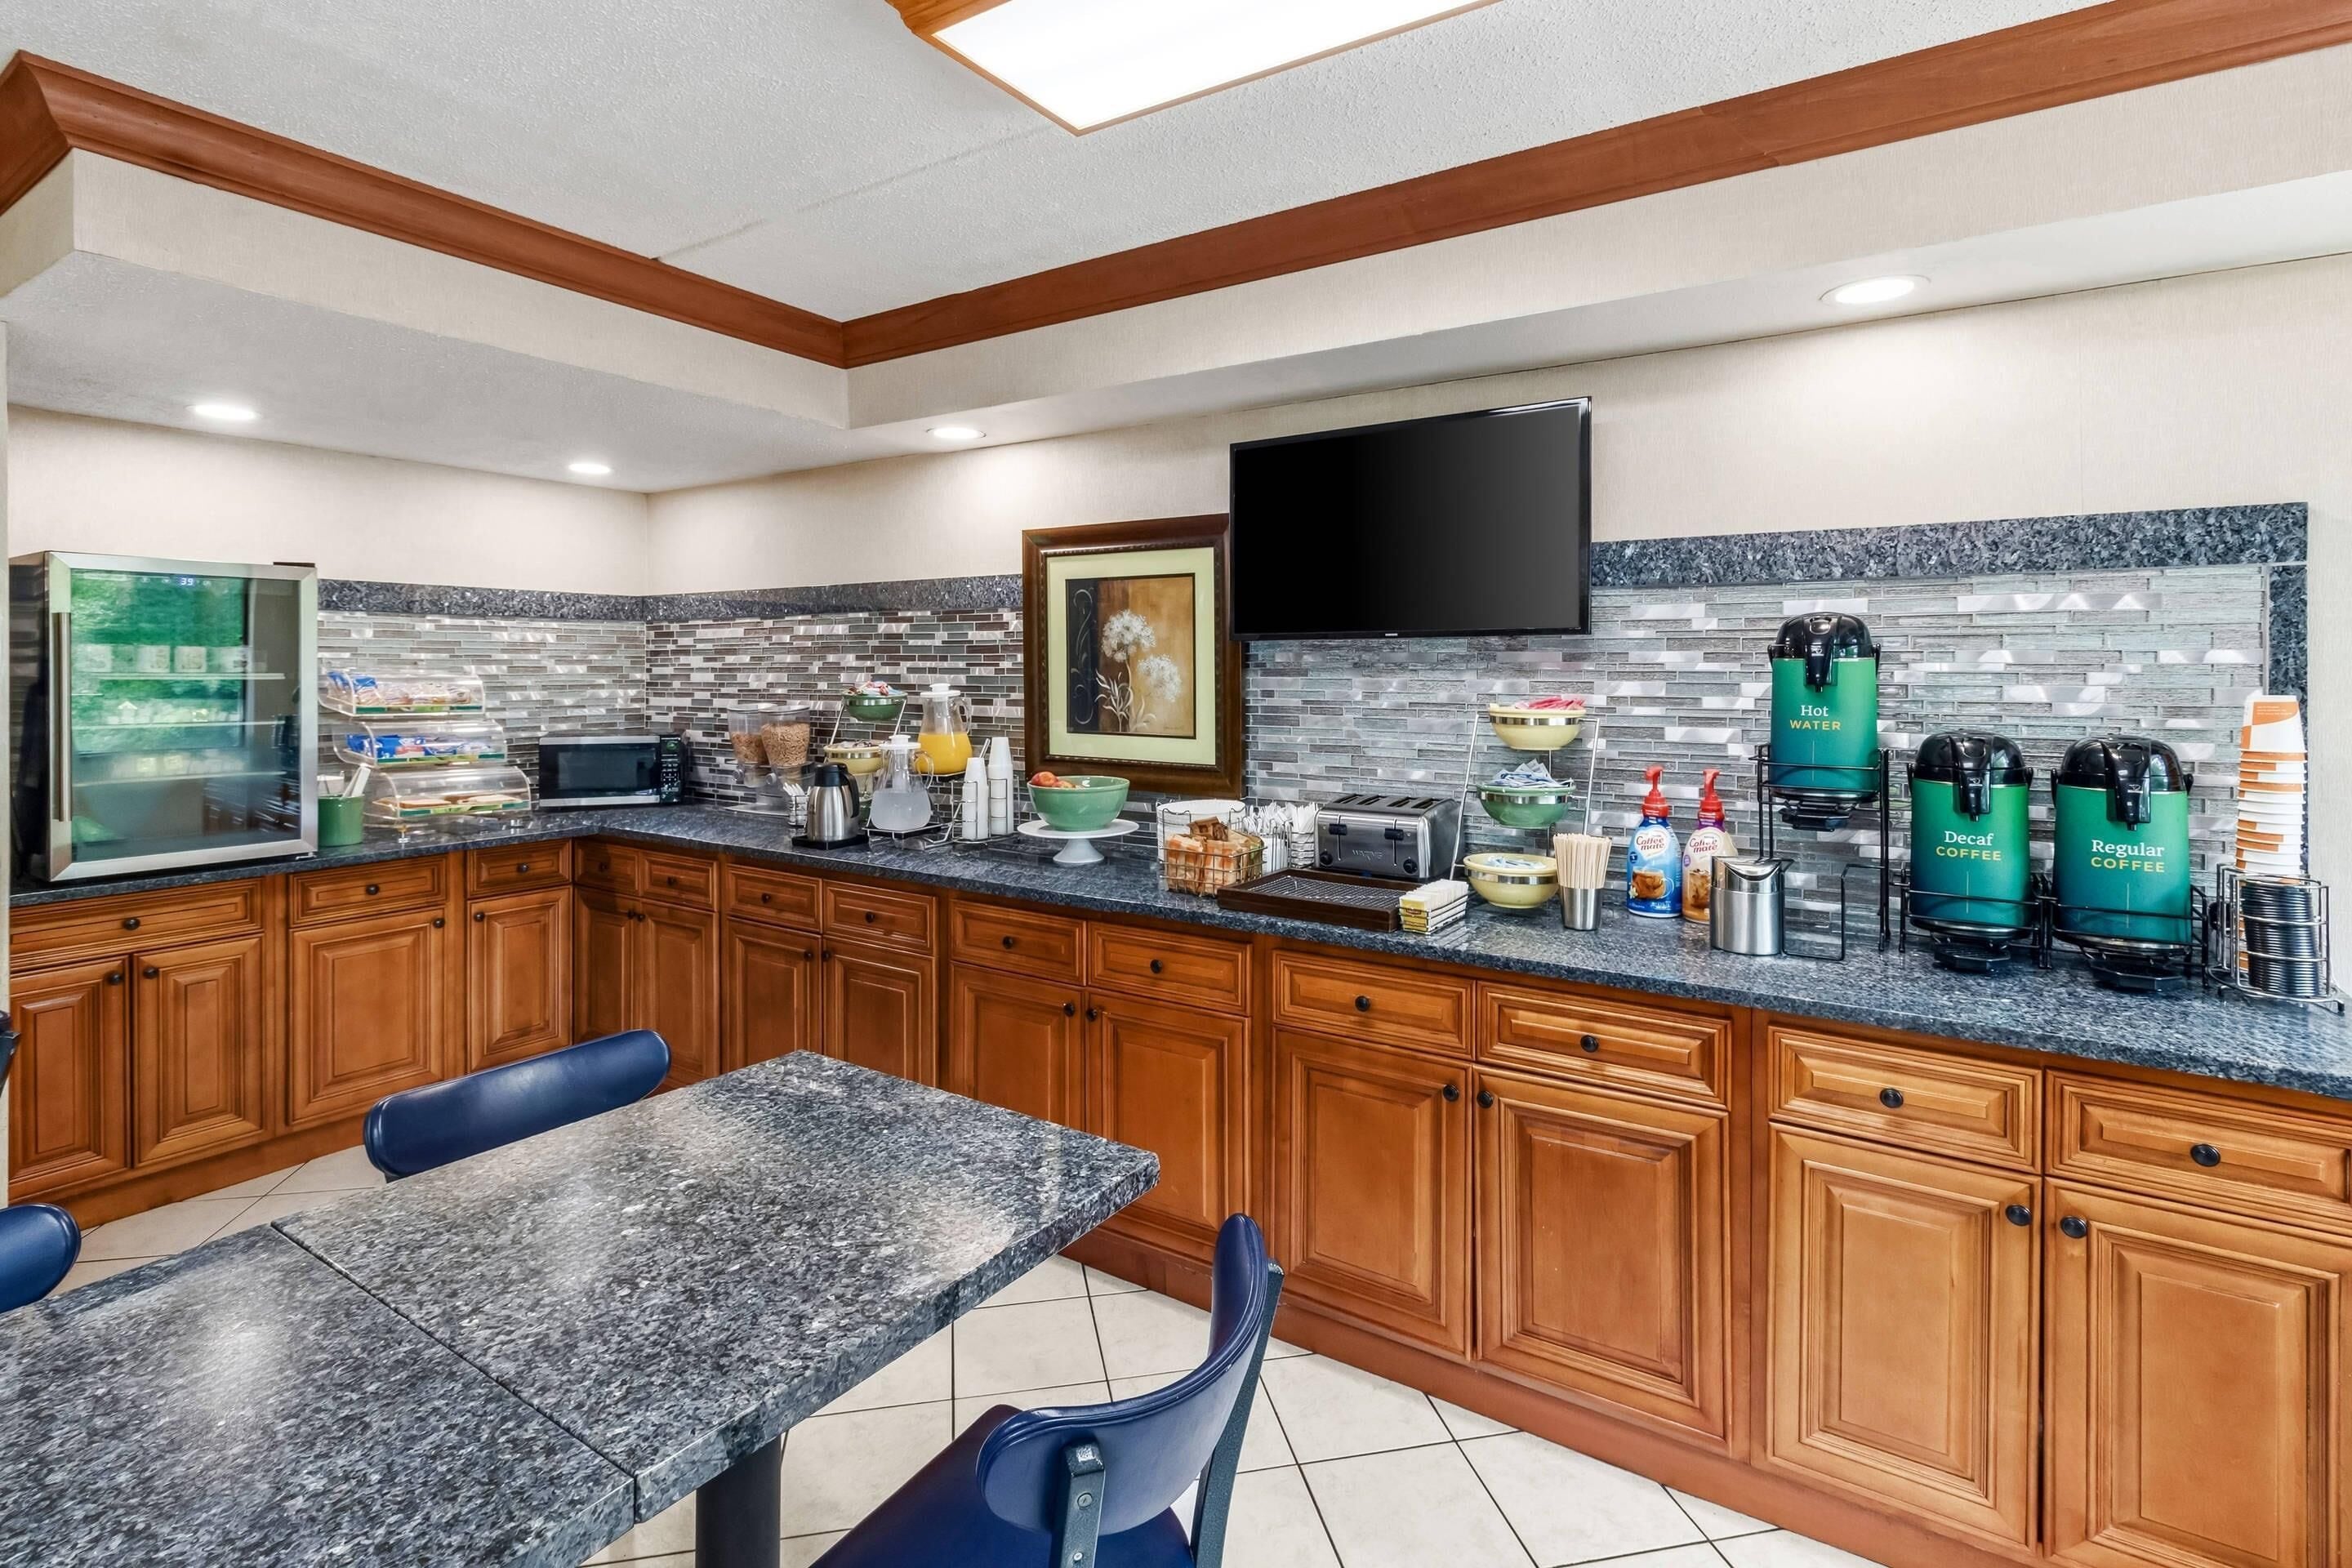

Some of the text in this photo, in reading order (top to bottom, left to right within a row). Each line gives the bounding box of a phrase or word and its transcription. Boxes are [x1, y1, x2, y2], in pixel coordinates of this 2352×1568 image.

[181, 577, 194, 586] 39
[1800, 705, 1829, 717] Hot
[1789, 719, 1842, 731] WATER
[1636, 835, 1664, 846] Coffee
[1944, 830, 1994, 846] Decaf
[1641, 843, 1664, 851] mate
[1693, 844, 1717, 853] mate
[2091, 839, 2165, 858] Regular
[1936, 846, 2002, 861] COFFEE
[2091, 857, 2165, 873] COFFEE
